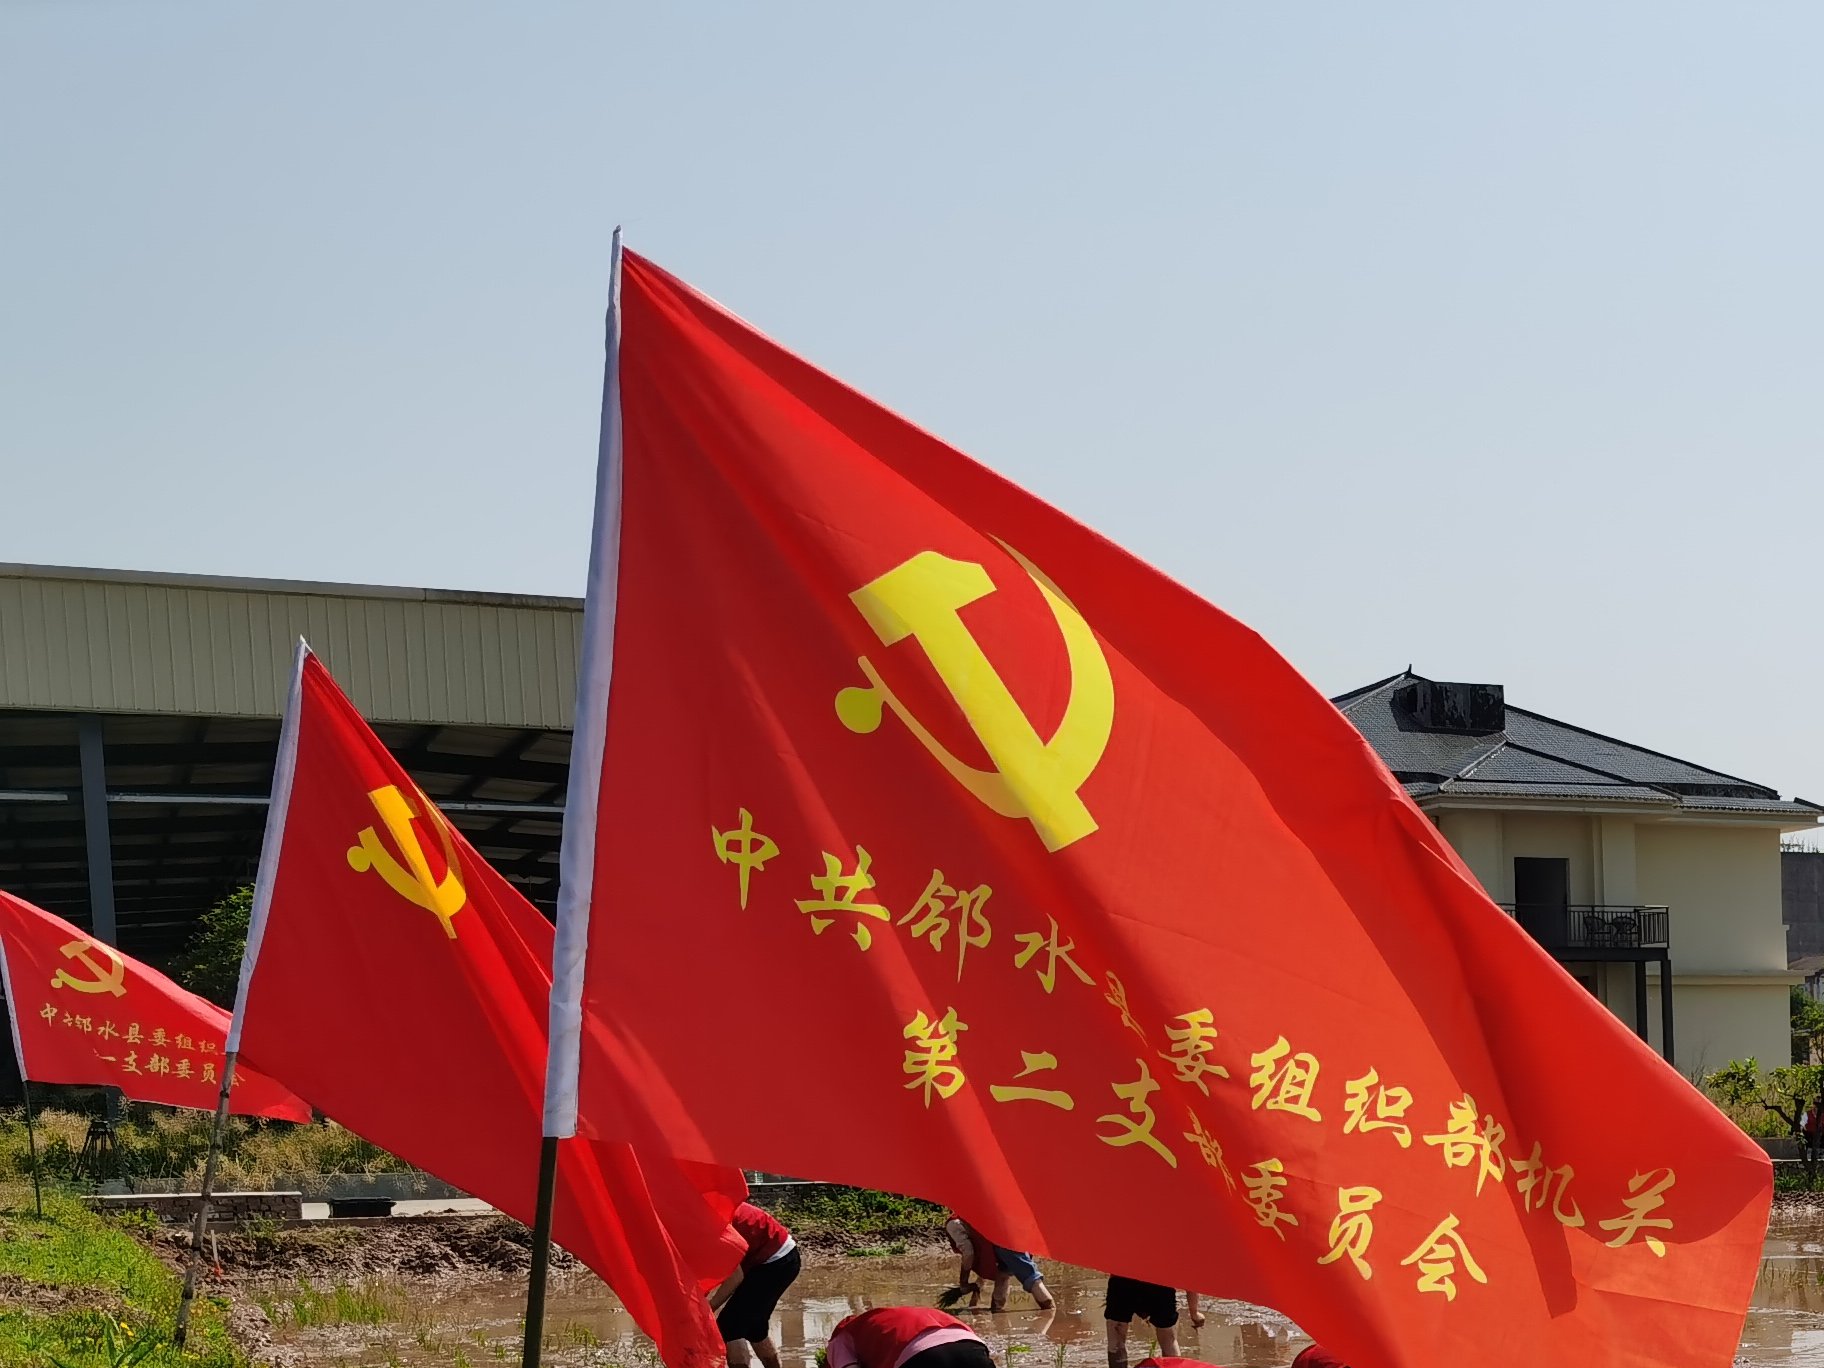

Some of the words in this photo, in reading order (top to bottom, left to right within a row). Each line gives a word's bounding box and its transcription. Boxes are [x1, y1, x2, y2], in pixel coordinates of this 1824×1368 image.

[40, 1003, 226, 1055] 中邻水县委组织
